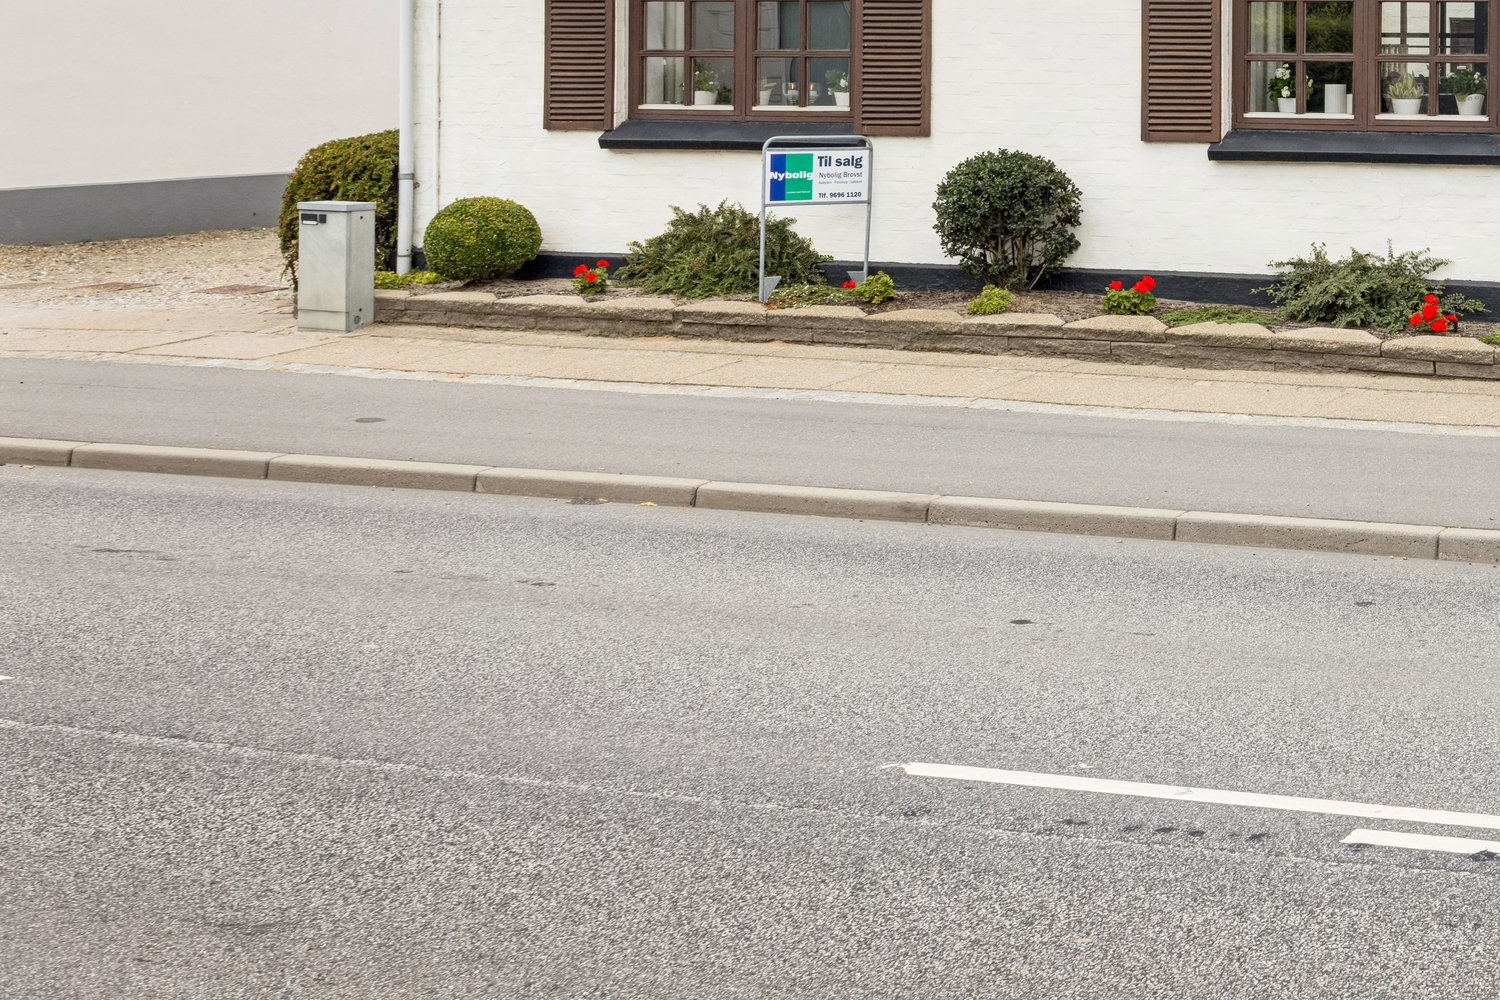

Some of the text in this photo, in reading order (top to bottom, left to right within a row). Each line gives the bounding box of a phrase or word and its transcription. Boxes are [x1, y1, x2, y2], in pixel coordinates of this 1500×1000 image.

[817, 155, 863, 169] Til salg
[770, 171, 813, 181] Nybolig
[819, 172, 842, 180] Nybolig
